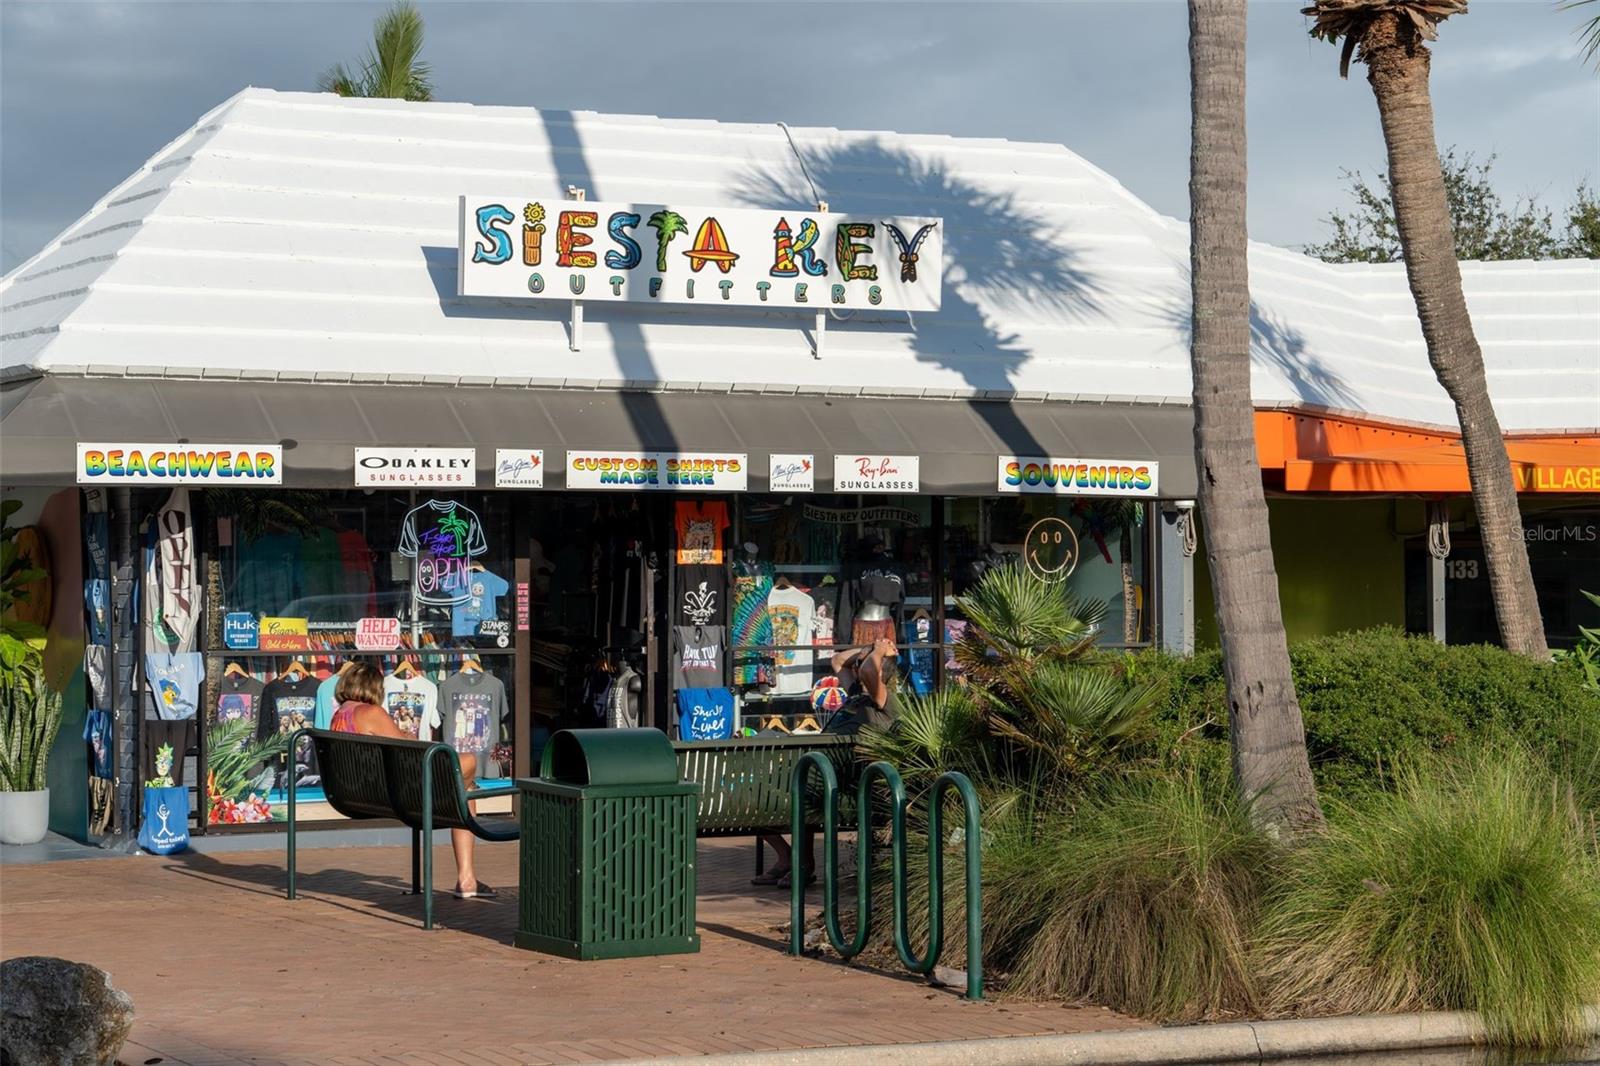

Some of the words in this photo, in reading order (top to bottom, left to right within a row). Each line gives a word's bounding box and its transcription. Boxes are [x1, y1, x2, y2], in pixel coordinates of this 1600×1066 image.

[769, 217, 938, 283] KEY
[528, 273, 882, 305] OUTFITTERS
[85, 450, 276, 478] BEACHWEAR
[392, 457, 471, 468] OAKLEY
[573, 457, 658, 471] CUSTOM
[666, 458, 741, 472] SHIRTS
[370, 473, 462, 482] SUNGLASSES
[600, 471, 659, 485] MADE
[667, 472, 714, 485] HERE
[1005, 462, 1152, 490] SOUVENIRS
[1518, 467, 1600, 489] VILLAGE
[840, 481, 913, 489] SUNGLASSES
[804, 506, 838, 522] SIESTA
[839, 511, 858, 522] KEY
[860, 508, 921, 524] OUTFITTERS
[429, 544, 456, 556] SHOP
[419, 557, 467, 592] OPEN
[227, 620, 256, 630] Huk
[268, 621, 298, 636] Cigars
[362, 619, 397, 633] HELP
[482, 620, 509, 631] STAMPS
[357, 634, 399, 646] WANTED
